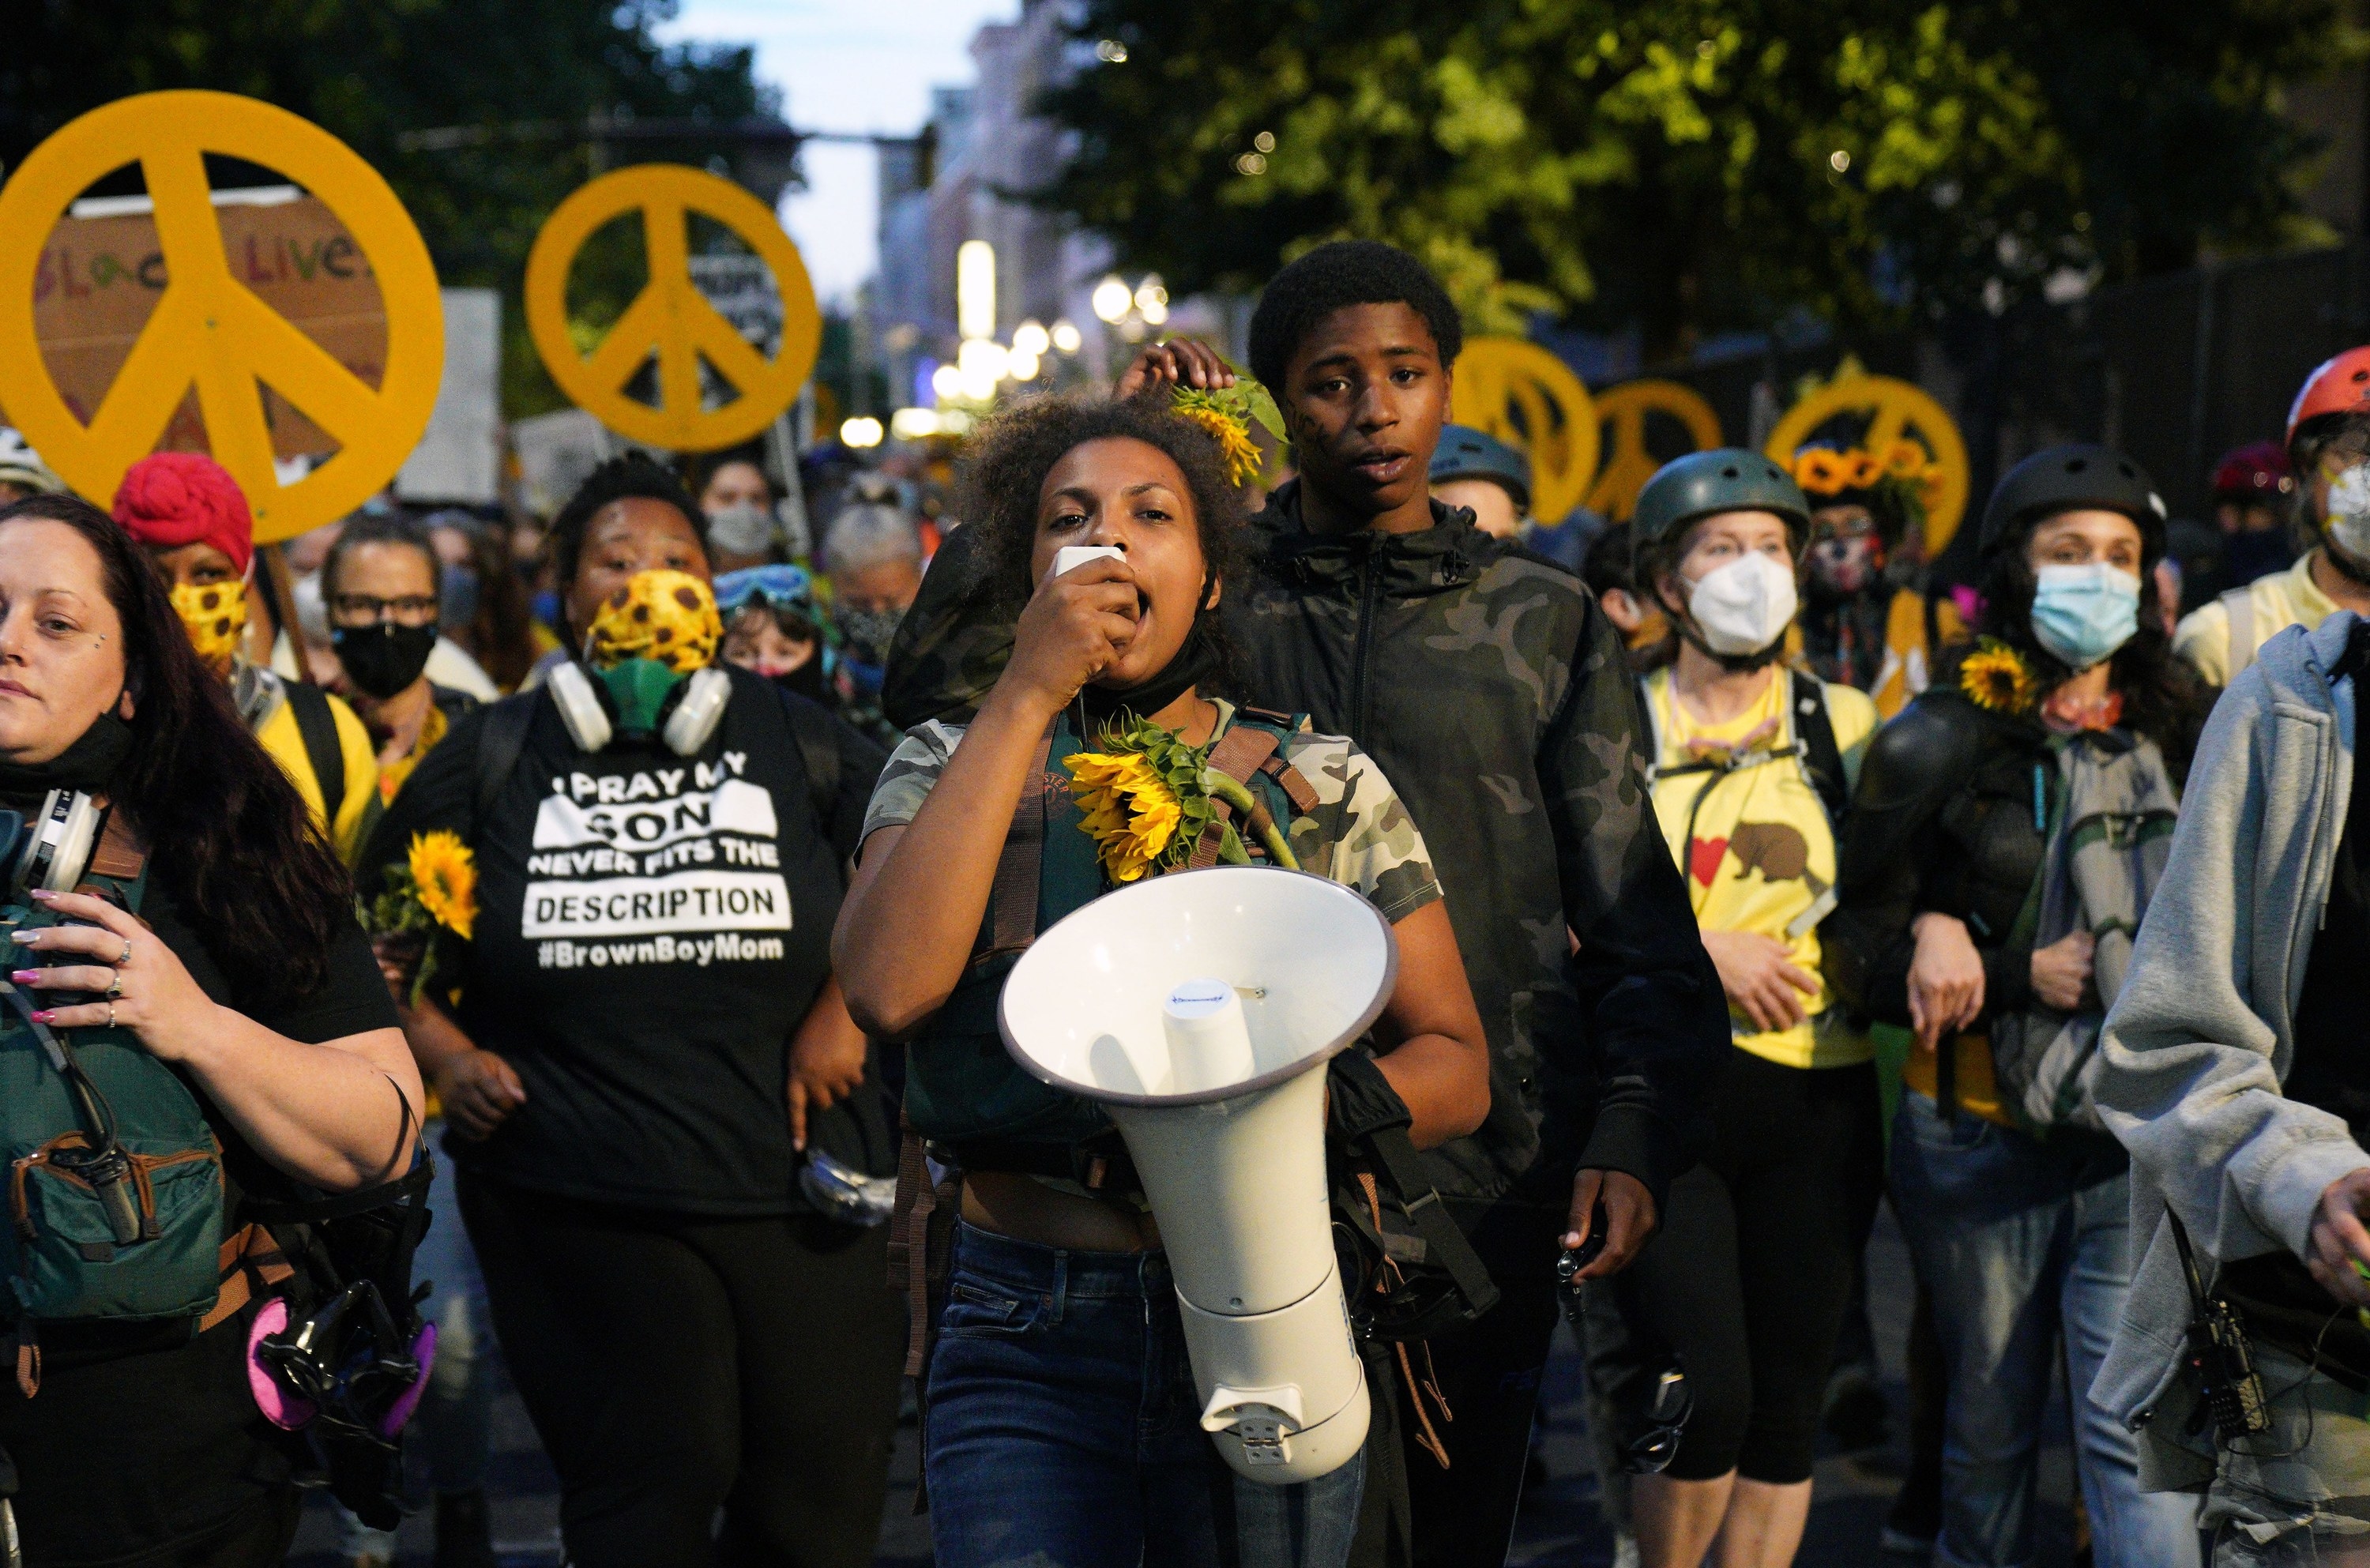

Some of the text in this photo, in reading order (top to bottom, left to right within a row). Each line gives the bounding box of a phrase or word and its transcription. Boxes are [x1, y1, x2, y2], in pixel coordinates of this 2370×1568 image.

[552, 750, 747, 803] I PRAY MY
[586, 802, 711, 842] SON
[527, 836, 780, 876] NEVER FITS THE
[536, 886, 775, 924] DESCRIPTION
[538, 934, 784, 969] #BrownBoyMom
